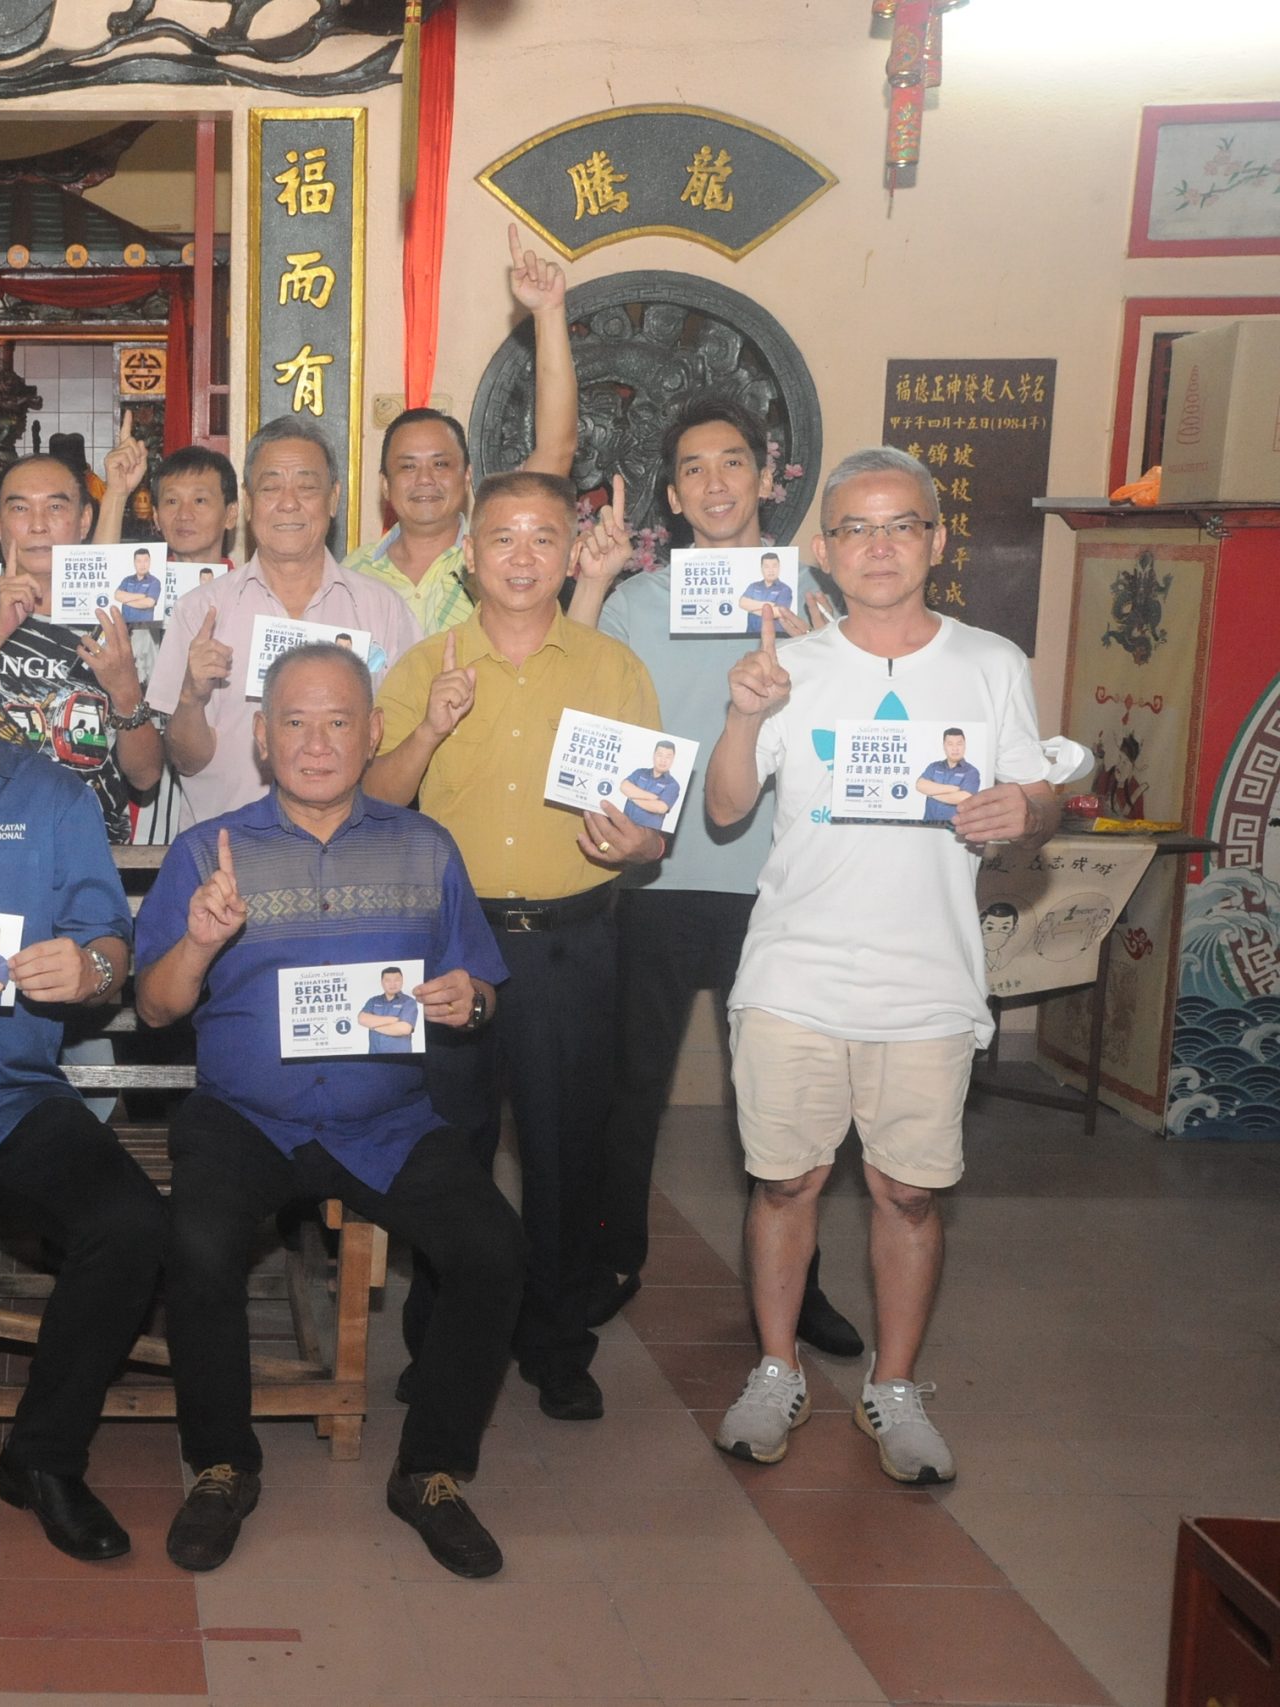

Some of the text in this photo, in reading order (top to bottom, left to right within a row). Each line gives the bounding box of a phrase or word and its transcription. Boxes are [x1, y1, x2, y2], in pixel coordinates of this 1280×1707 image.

[65, 563, 107, 571] BERSIH
[685, 567, 731, 576] BERSIH
[65, 572, 106, 580] STABIL
[685, 577, 730, 585] STABIL
[572, 733, 621, 752] BERSIH
[852, 742, 907, 752] BERSIH
[569, 743, 617, 763] STABIL
[852, 753, 906, 763] STABIL
[295, 983, 347, 995] BERSIH
[295, 994, 347, 1005] STABIL
